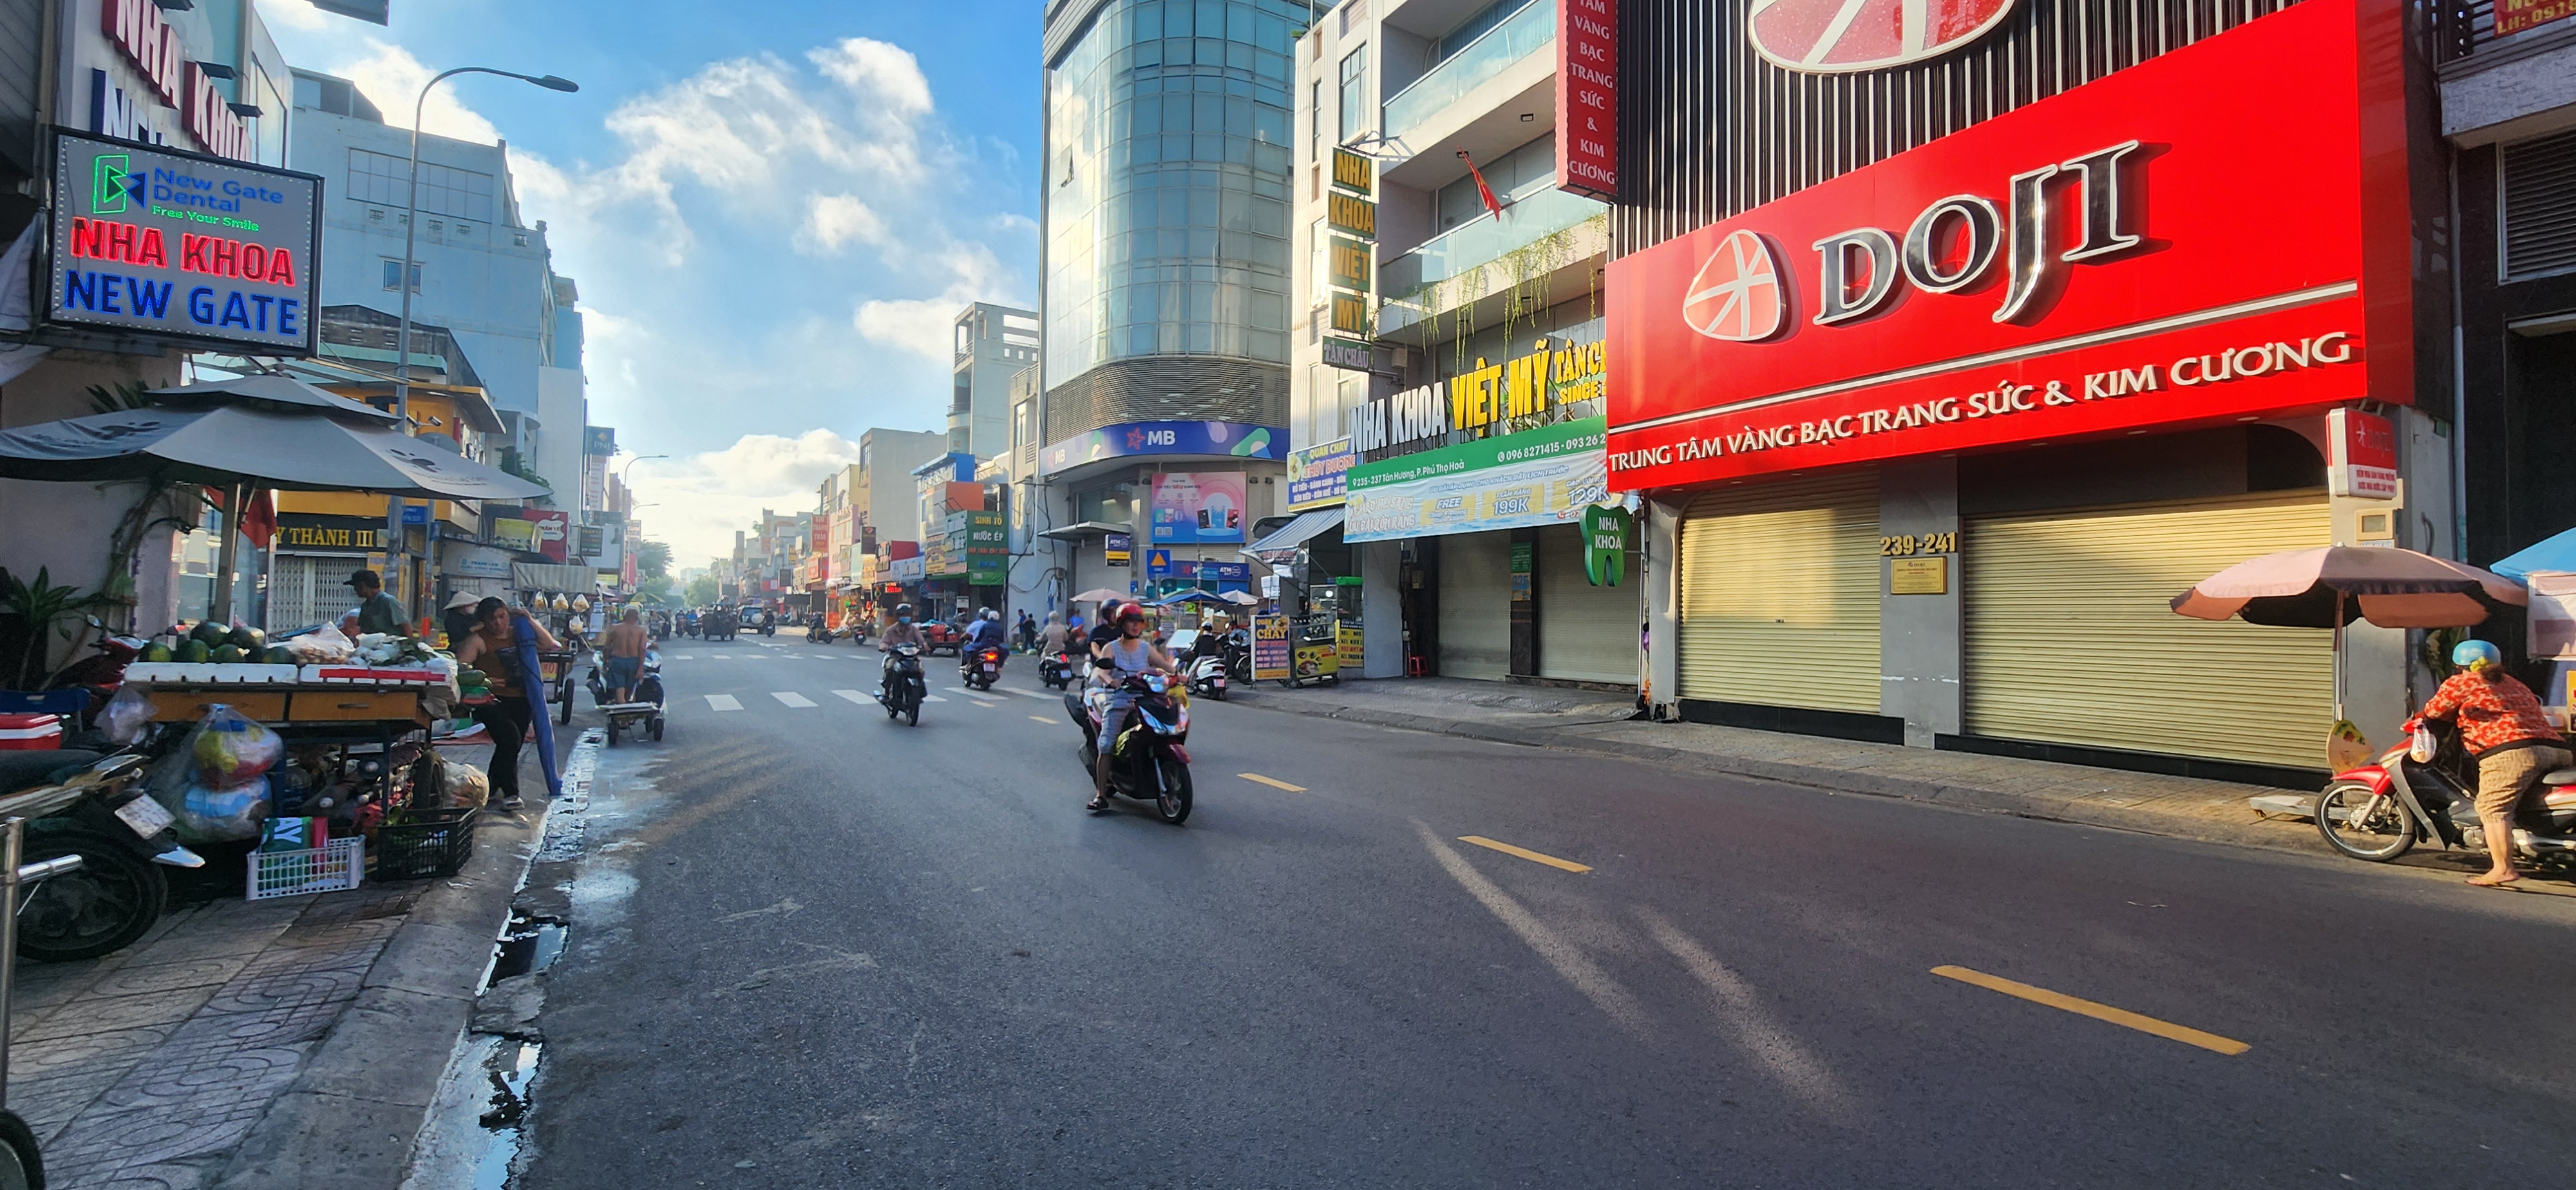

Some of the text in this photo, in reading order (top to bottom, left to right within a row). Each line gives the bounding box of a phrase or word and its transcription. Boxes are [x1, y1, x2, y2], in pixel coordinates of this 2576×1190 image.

[1574, 14, 1610, 40] VÀNG
[1579, 42, 1606, 63] BẠC
[1570, 62, 1614, 89] TRANG
[1579, 88, 1605, 111] SỨC
[1587, 117, 1598, 132] &
[1580, 142, 1605, 158] KIM
[155, 167, 284, 204] New Gate
[1335, 158, 1370, 191] NHA
[1569, 160, 1615, 185] CƯƠNG
[153, 184, 241, 213] Dental
[151, 205, 260, 232] Free Your Smile
[1329, 197, 1374, 234] KHOA
[1812, 139, 2139, 325] DOJI
[70, 216, 296, 287] NHA KHOA
[1333, 243, 1370, 289] VIỆT
[65, 269, 299, 336] NEW GATE
[1336, 294, 1365, 332] MỸ
[1324, 342, 1369, 369] TÂN CHÂU
[1555, 339, 1586, 384] TÂN
[1353, 337, 1553, 452] NHA KHOA VIỆT MỸ
[1558, 382, 1598, 405] SINCE
[1608, 330, 2353, 473] TRUNG TÂM VÀNG BẠC TRANG SỨC & KIM CƯƠNG
[594, 440, 611, 451] PNJ
[1148, 430, 1176, 446] MB
[1506, 449, 1522, 461] 096
[1524, 441, 1560, 458] 8271415
[1566, 437, 1584, 450] 093
[1586, 434, 1598, 446] 26
[1054, 448, 1066, 464] MB
[1357, 477, 1368, 487] 235
[1371, 475, 1382, 484] 237
[1382, 473, 1393, 482] Tân
[1423, 464, 1435, 475] Phú
[1435, 464, 1448, 474] Thọ
[1448, 458, 1465, 471] Hoà
[1490, 473, 1513, 484] KHÁCH
[1435, 496, 1463, 509] FREE
[1493, 497, 1530, 515] 199K
[289, 523, 350, 547] THÀNH
[355, 530, 374, 548] III
[1598, 516, 1620, 532] NHA
[1595, 534, 1623, 550] KHOA
[1880, 532, 1956, 555] 239-241
[1256, 628, 1285, 639] CHAY
